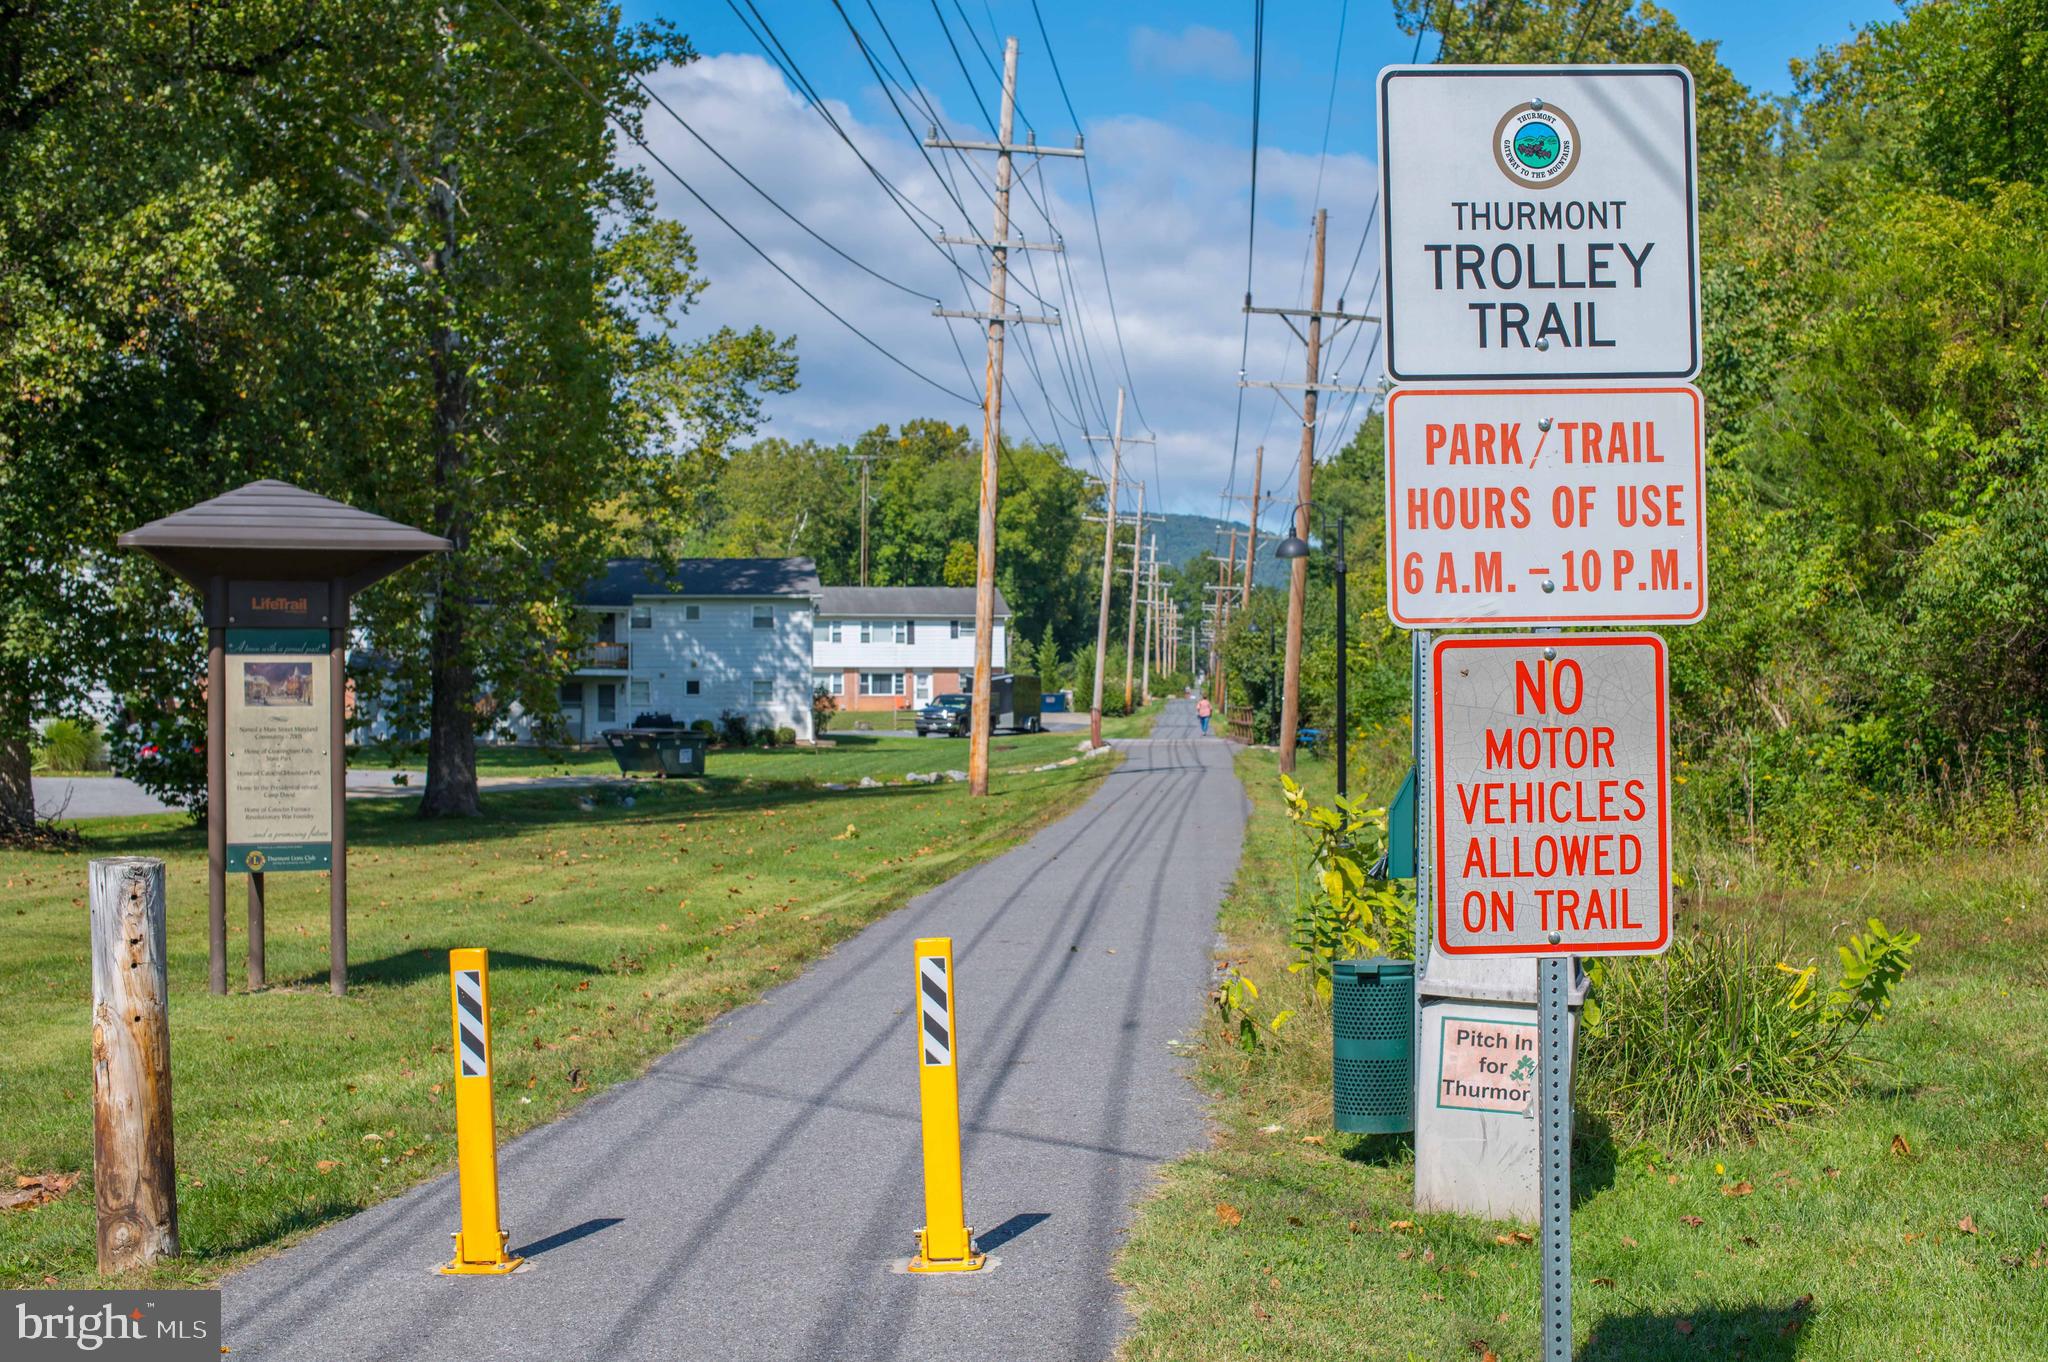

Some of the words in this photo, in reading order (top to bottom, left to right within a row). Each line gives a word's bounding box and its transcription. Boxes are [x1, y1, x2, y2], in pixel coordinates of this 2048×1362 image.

[1516, 112, 1557, 124] THURMONT
[1503, 139, 1521, 170] GATEWAY
[1520, 167, 1530, 176] TO
[1531, 171, 1546, 179] THE
[1547, 140, 1570, 177] MOUNTAINS
[1451, 200, 1627, 231] THURMONT
[1423, 242, 1655, 290] TROLLEY
[1468, 301, 1616, 349] TRAIL
[1407, 486, 1531, 530] HOURS
[1552, 485, 1596, 529] OF
[1616, 484, 1685, 527] USE
[1403, 551, 1424, 595] 6
[1435, 551, 1517, 594] A.M.
[1561, 549, 1602, 592] 10
[1613, 548, 1692, 591] P.M.
[251, 596, 308, 610] LifeTrail
[1515, 658, 1584, 715] NO
[1485, 726, 1615, 770] MOTOR
[263, 791, 279, 799] Camp
[279, 791, 296, 799] David
[1456, 779, 1646, 825] VEHICLES
[1462, 834, 1642, 879] ALLOWED
[1462, 890, 1514, 933] ON
[1534, 888, 1642, 931] TRAIL
[1456, 1029, 1508, 1049] Pitch
[1515, 1034, 1533, 1051] In
[1479, 1056, 1508, 1075] for
